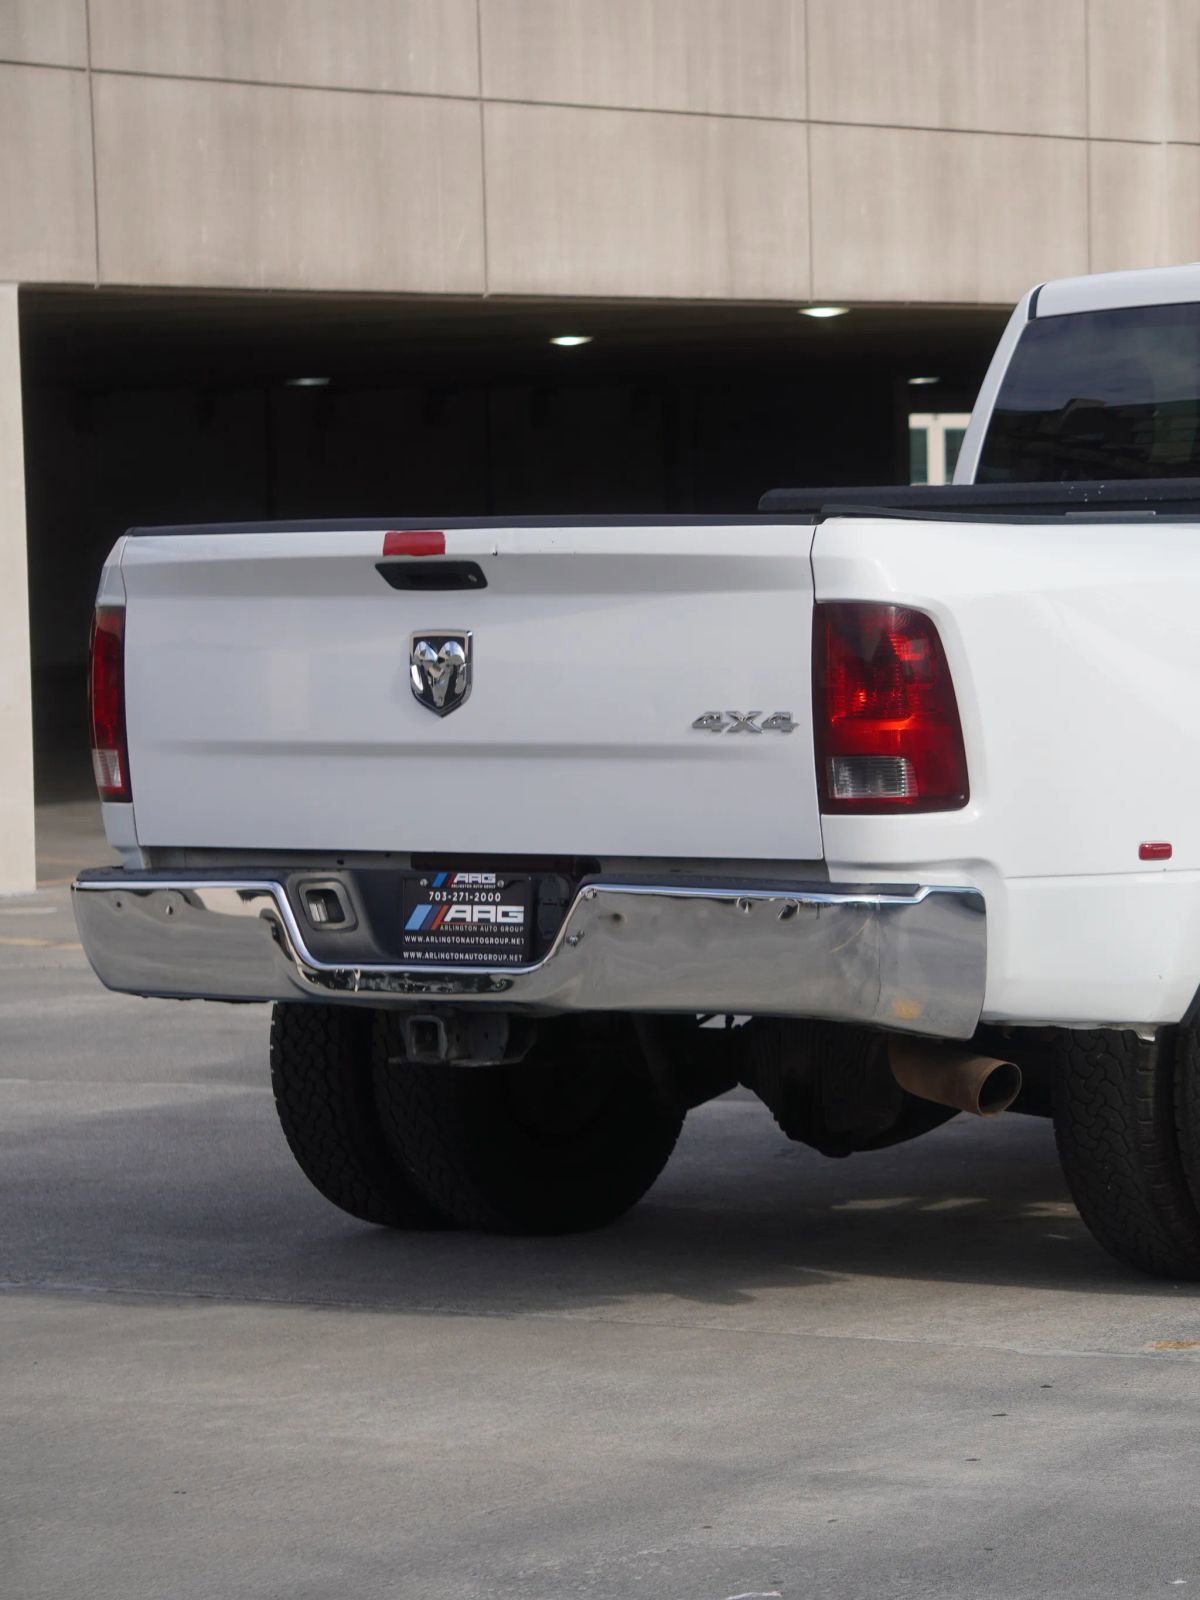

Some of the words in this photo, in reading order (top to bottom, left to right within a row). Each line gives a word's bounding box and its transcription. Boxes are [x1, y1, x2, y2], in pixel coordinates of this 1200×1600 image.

[691, 710, 800, 734] 4X4
[453, 872, 496, 884] AAG
[428, 891, 501, 902] 703-271-2000
[443, 904, 525, 923] AAG
[439, 924, 477, 932] ARLINGTON
[480, 925, 498, 933] AUTO
[500, 925, 524, 933] GROUP
[403, 951, 523, 962] WWW.ARLINGTONAUTOGROUP.NET
